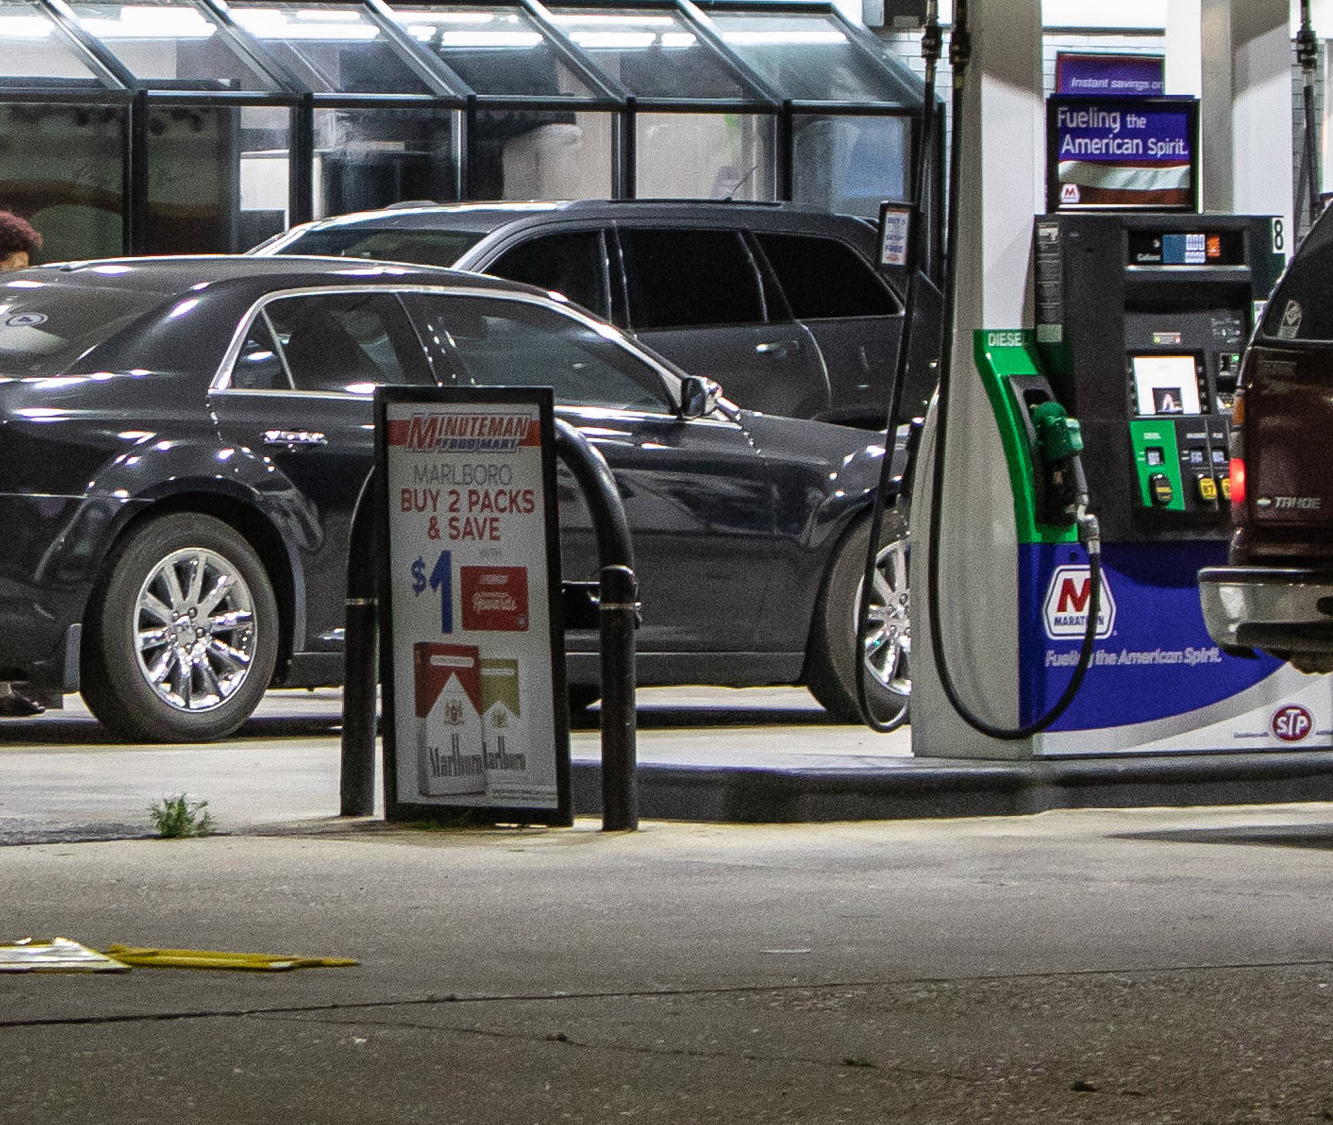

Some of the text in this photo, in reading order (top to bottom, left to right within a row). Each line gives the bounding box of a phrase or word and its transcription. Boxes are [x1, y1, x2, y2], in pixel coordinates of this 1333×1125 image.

[1071, 77, 1109, 89] Instant
[1111, 78, 1150, 91] savings
[1058, 107, 1147, 133] Fueling the
[1061, 133, 1189, 158] American Spirit.
[1273, 219, 1284, 251] 8
[407, 416, 530, 449] MINUTEMAN
[479, 438, 518, 450] MART
[413, 463, 513, 486] MARLBORO
[401, 487, 536, 514] BUY 2 PACKS
[1274, 496, 1322, 509] TAHOE
[427, 515, 502, 541] & SAVE
[410, 549, 453, 635] $1
[1056, 578, 1090, 613] M
[1095, 649, 1118, 665] the
[1117, 647, 1184, 666] American
[1276, 709, 1310, 736] STP
